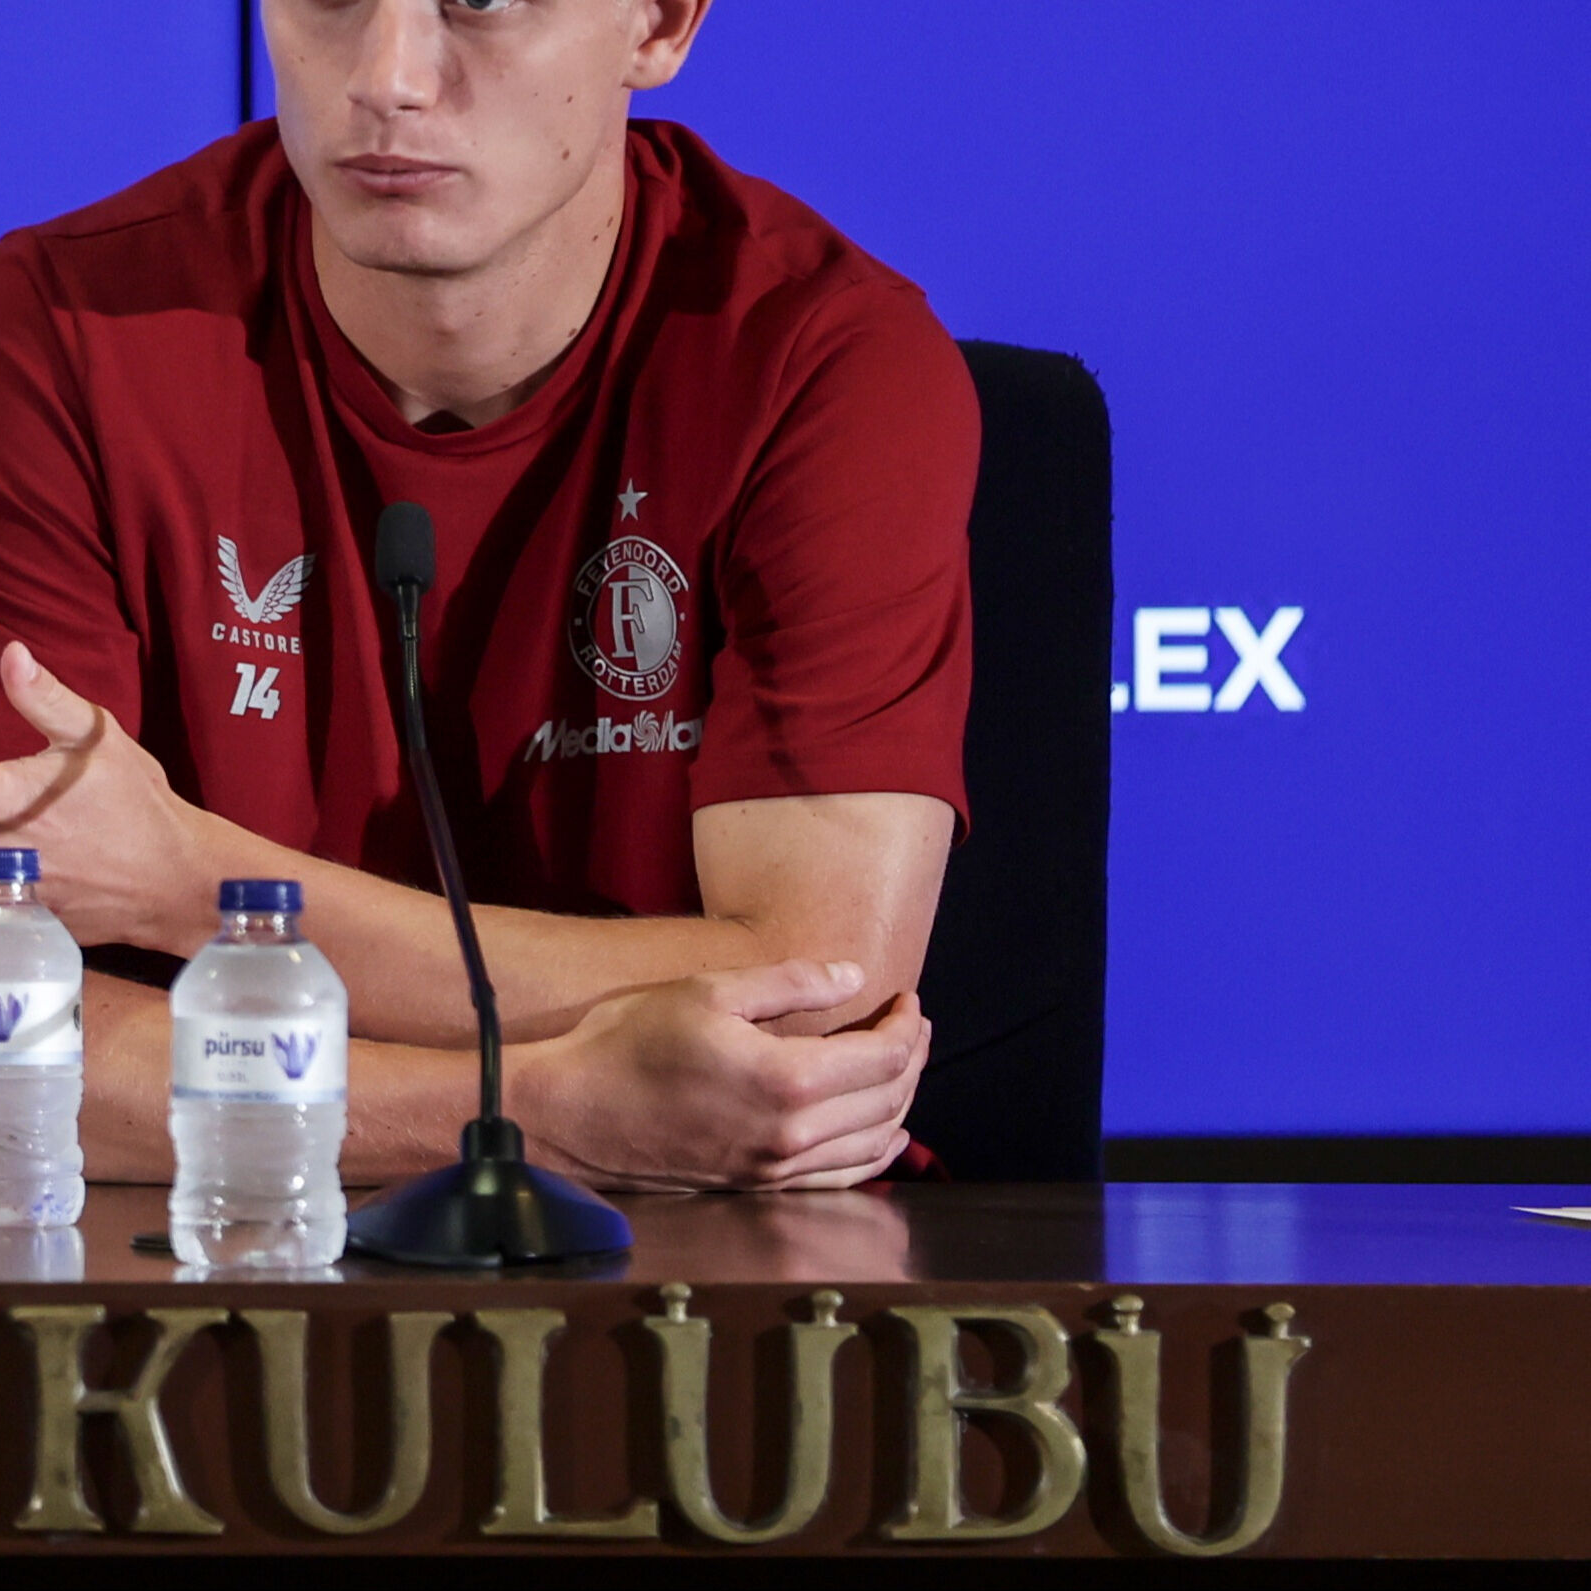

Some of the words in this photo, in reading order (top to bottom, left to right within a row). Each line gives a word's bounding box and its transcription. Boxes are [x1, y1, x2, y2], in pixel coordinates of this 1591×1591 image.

[576, 542, 683, 598] FEYENOORD
[211, 621, 301, 655] CASTORE
[1110, 606, 1307, 713] EX
[229, 661, 281, 720] 14
[579, 639, 683, 695] ROTTERDAM
[204, 1031, 266, 1059] pürsu
[9, 1281, 1312, 1558] KULÜBÜ
